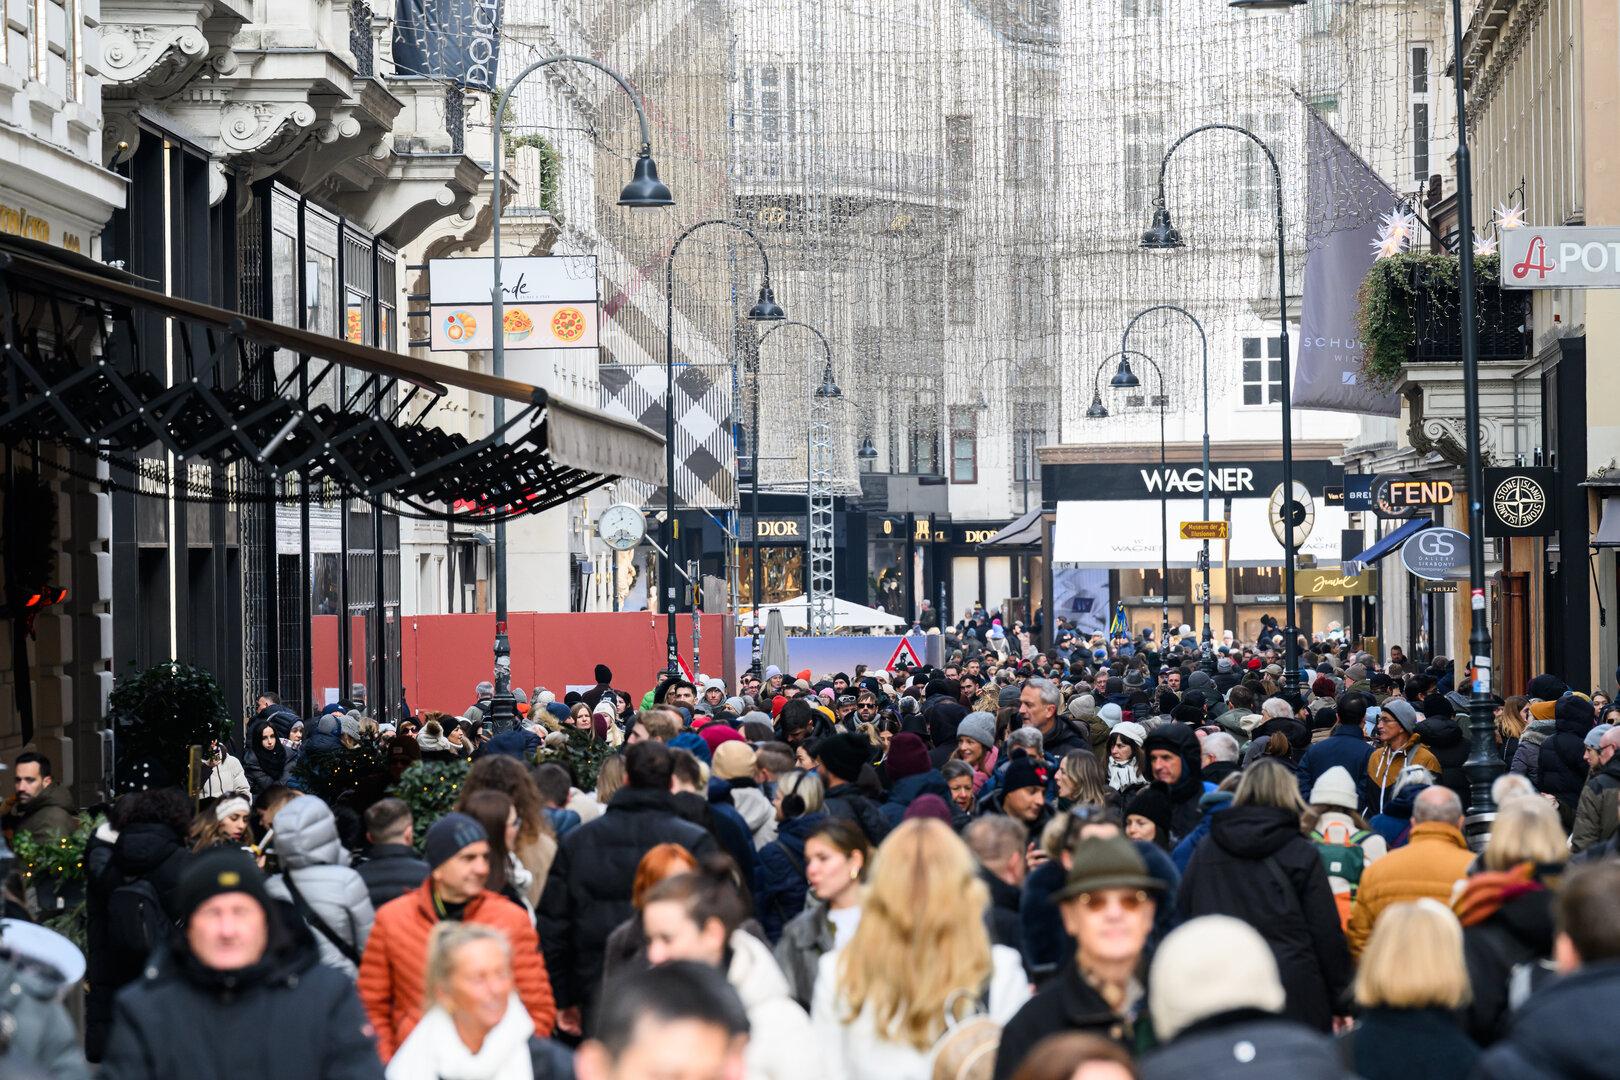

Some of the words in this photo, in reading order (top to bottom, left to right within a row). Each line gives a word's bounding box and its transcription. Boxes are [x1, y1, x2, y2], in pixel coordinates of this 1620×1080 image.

[1303, 337, 1360, 349] SCHU
[1140, 467, 1254, 493] WAGNER
[1496, 479, 1517, 500] STONE
[1520, 479, 1542, 500] ISLAND
[757, 521, 799, 536] DIOR
[1111, 545, 1162, 553] WAGNE
[1418, 531, 1455, 556] GS
